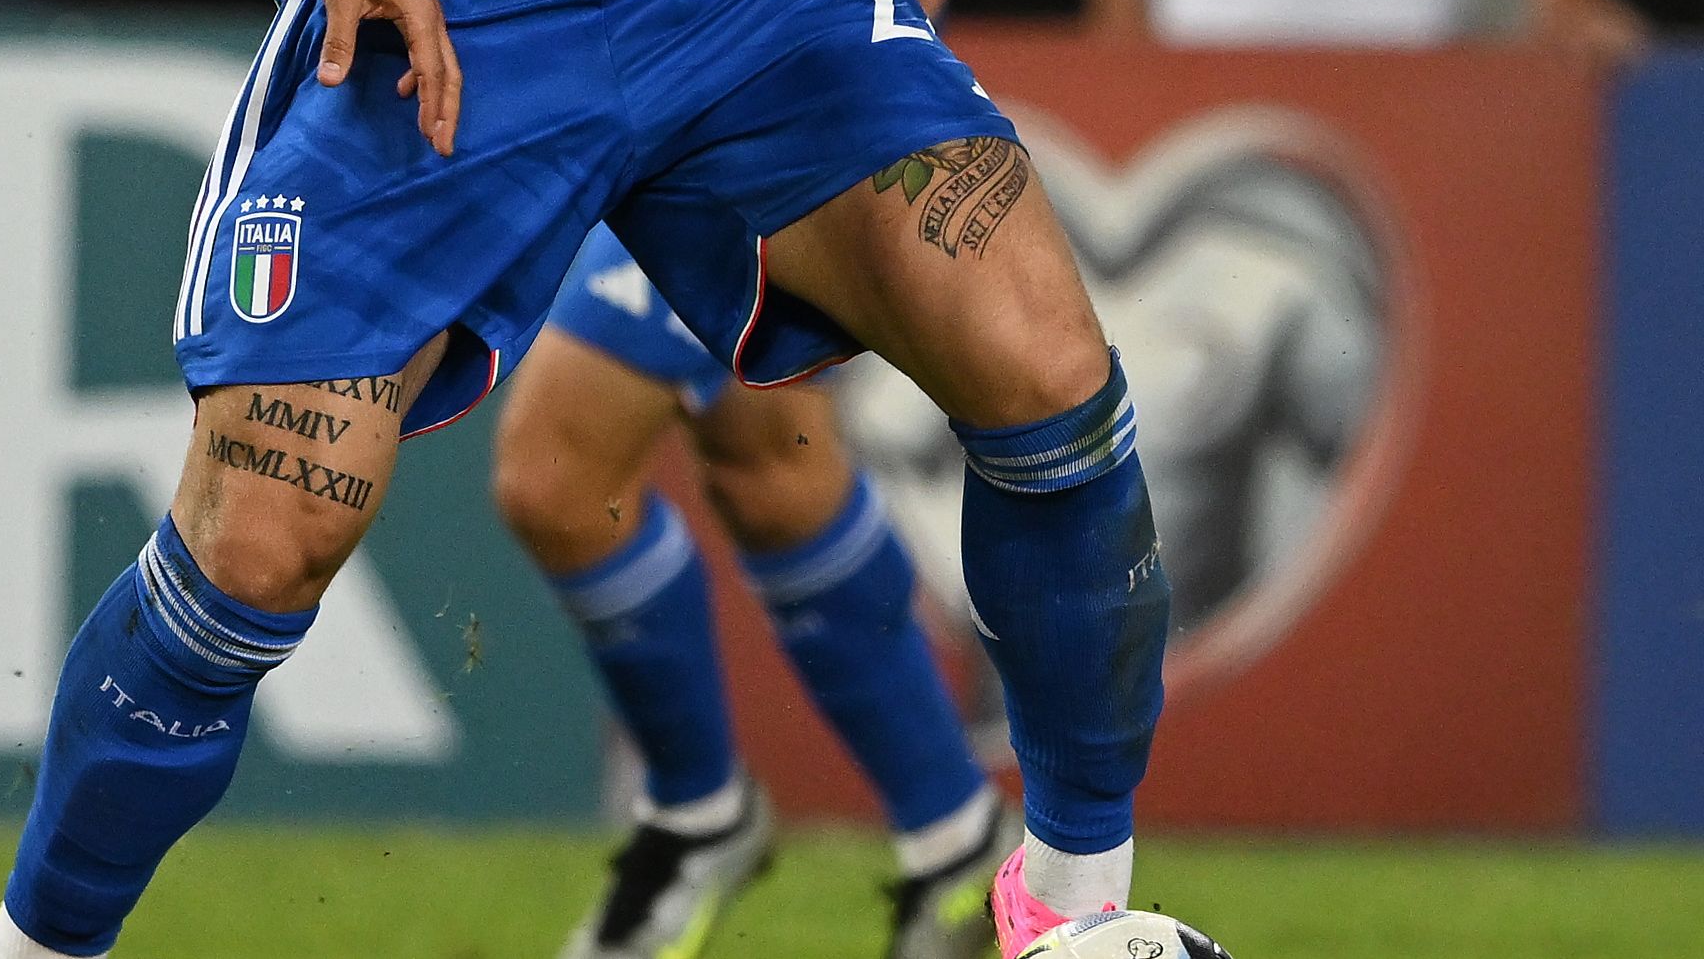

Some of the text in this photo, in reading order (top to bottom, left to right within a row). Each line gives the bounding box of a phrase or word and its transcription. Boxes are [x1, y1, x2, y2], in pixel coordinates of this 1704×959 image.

[239, 222, 292, 244] ITALIA
[246, 393, 352, 444] MMIV
[206, 430, 373, 512] MCMLXXIII
[99, 675, 230, 738] ITALIA
